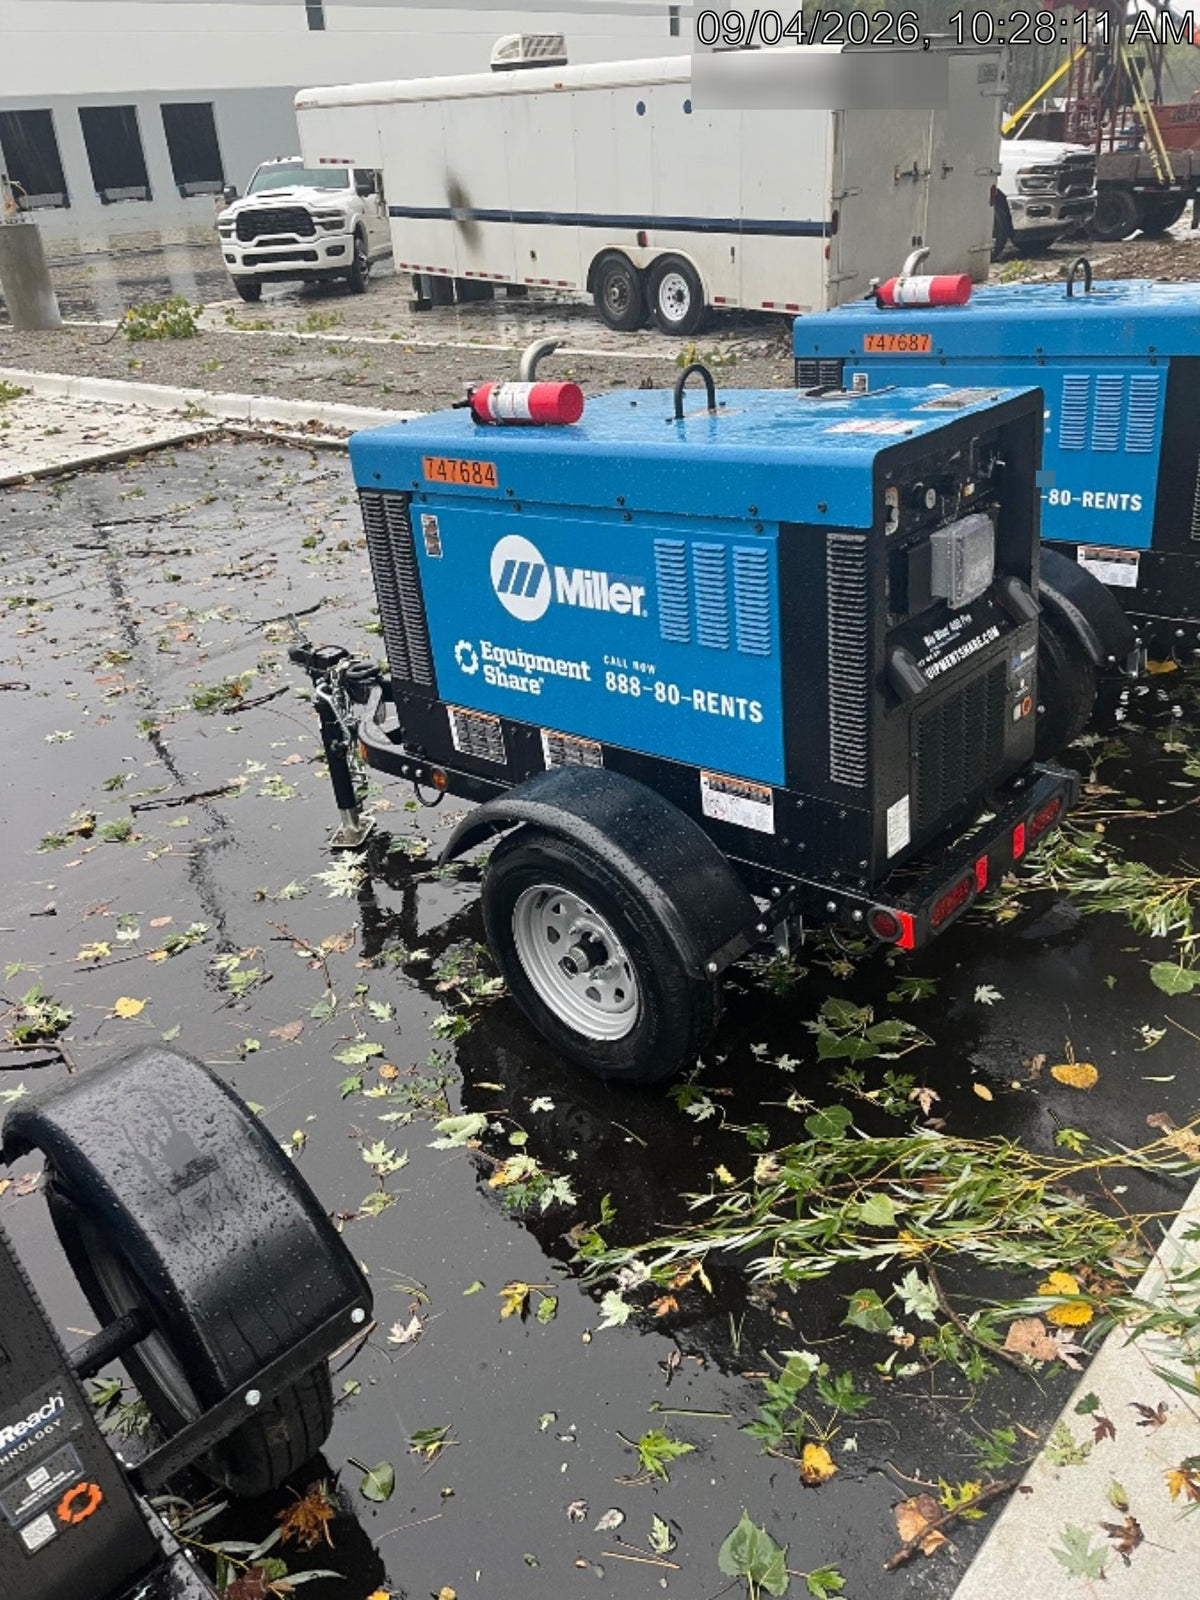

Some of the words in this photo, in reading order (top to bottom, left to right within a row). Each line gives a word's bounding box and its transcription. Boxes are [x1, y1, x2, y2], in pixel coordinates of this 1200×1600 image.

[866, 334, 930, 352] 747687
[426, 458, 495, 487] 747684
[555, 567, 644, 616] Miller
[480, 640, 592, 682] Equipment
[603, 654, 628, 670] CALL
[632, 660, 656, 675] NOW
[925, 625, 1001, 680] UIPMENTSHARE.COM
[483, 665, 541, 695] Share
[605, 671, 763, 724] 888-80-RENTS
